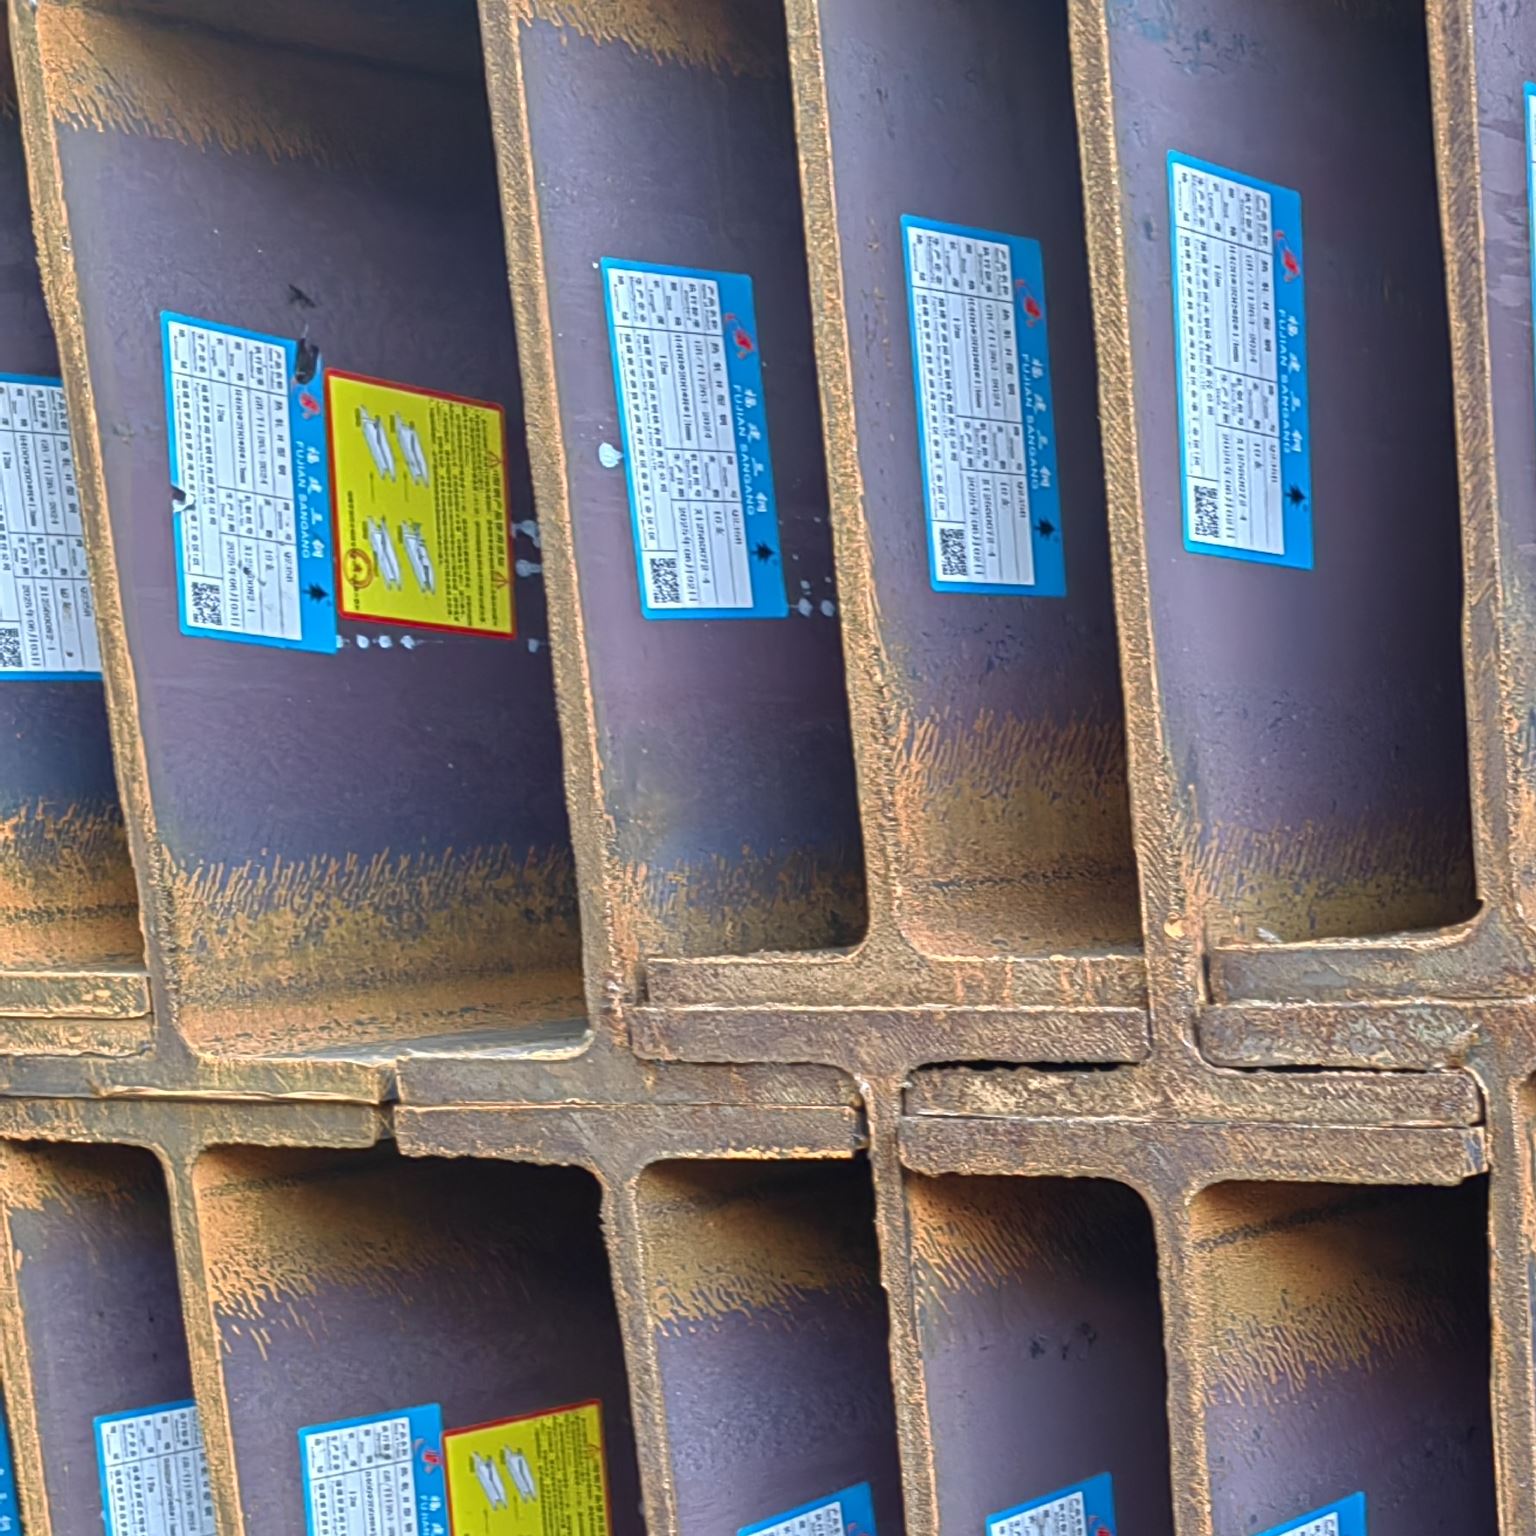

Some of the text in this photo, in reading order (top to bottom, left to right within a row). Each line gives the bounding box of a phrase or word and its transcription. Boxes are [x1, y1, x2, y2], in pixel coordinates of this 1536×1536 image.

[273, 399, 287, 476] 热轧H型钢
[1021, 353, 1038, 489] FUJIAN SANGANG
[1030, 357, 1051, 487] 福建三钢
[1278, 308, 1290, 453] FUJIAN SANGANG
[1287, 314, 1302, 453] 福建三钢
[294, 440, 310, 559] FUJIAN SANGANG
[305, 445, 326, 558] 福建三钢
[732, 384, 755, 514] FUJIAN SANGANG
[743, 388, 769, 512] 福建三钢
[419, 1494, 429, 1536] FUJIAN
